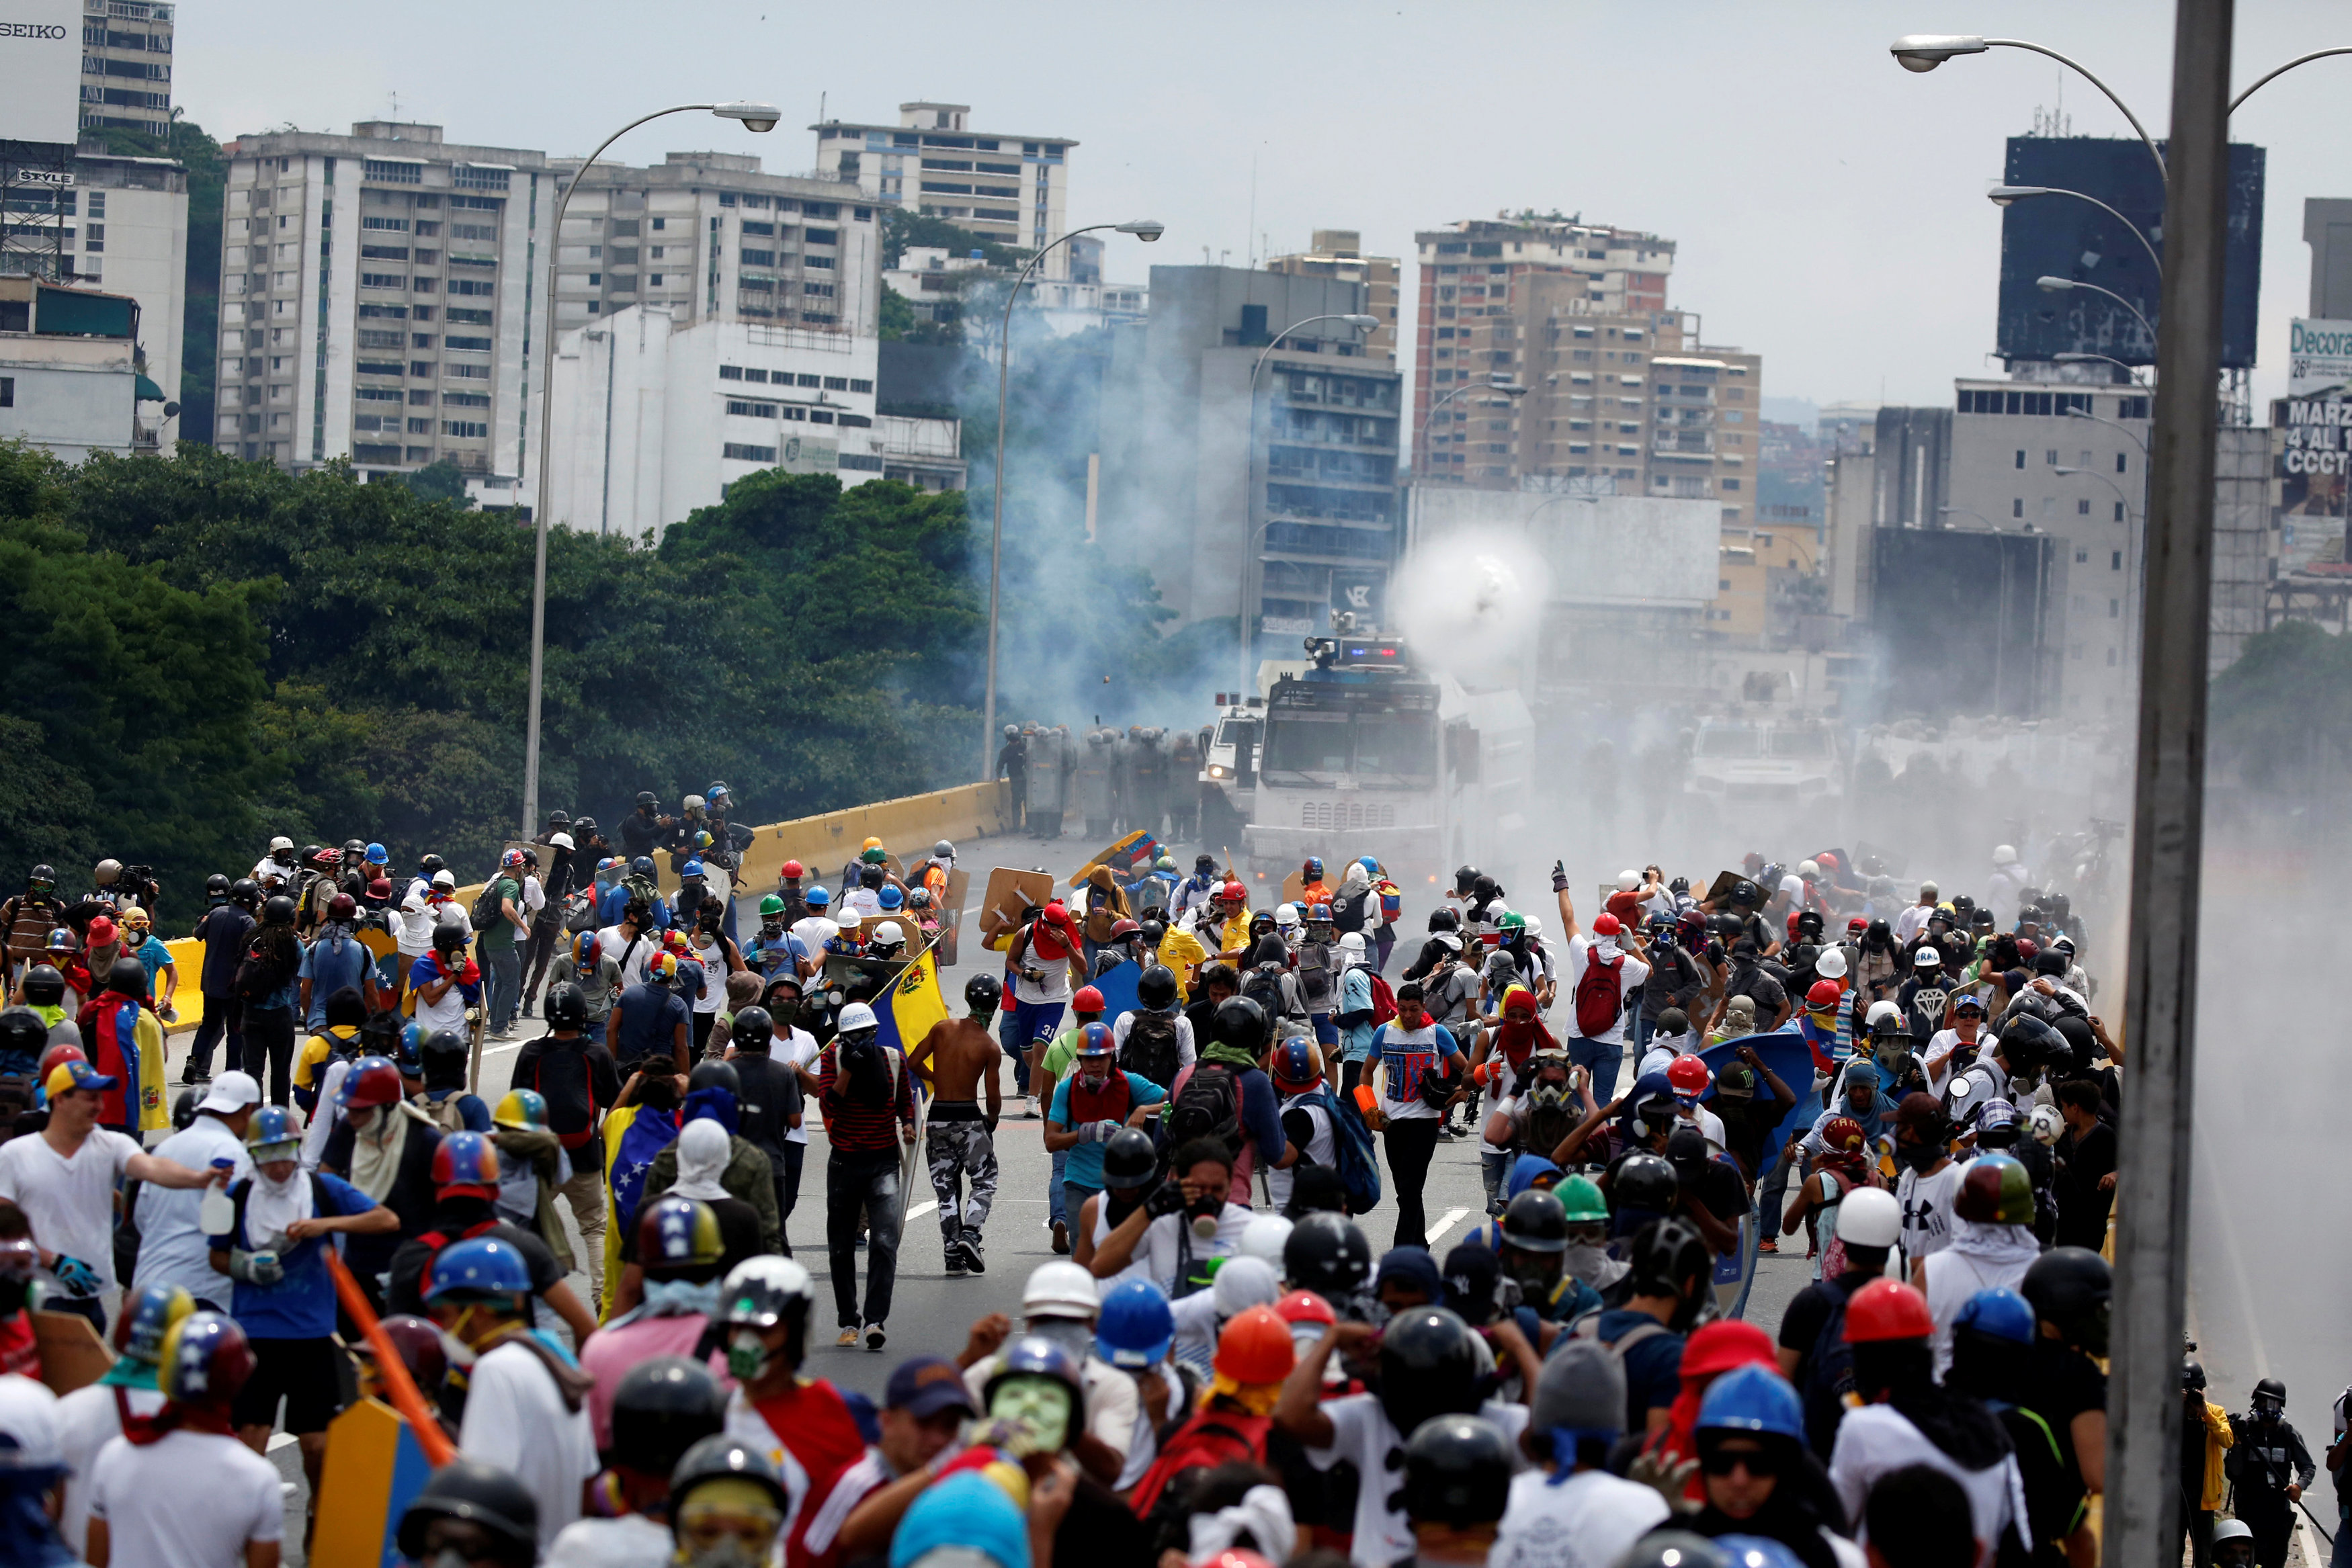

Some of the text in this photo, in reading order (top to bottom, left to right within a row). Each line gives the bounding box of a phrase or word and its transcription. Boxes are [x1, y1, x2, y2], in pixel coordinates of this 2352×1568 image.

[0, 23, 66, 39] SEIKO
[20, 171, 71, 183] STYLE
[2288, 427, 2302, 448] 4
[2309, 427, 2335, 449] AL
[2287, 449, 2349, 476] CCCT
[1041, 1024, 1055, 1039] 31
